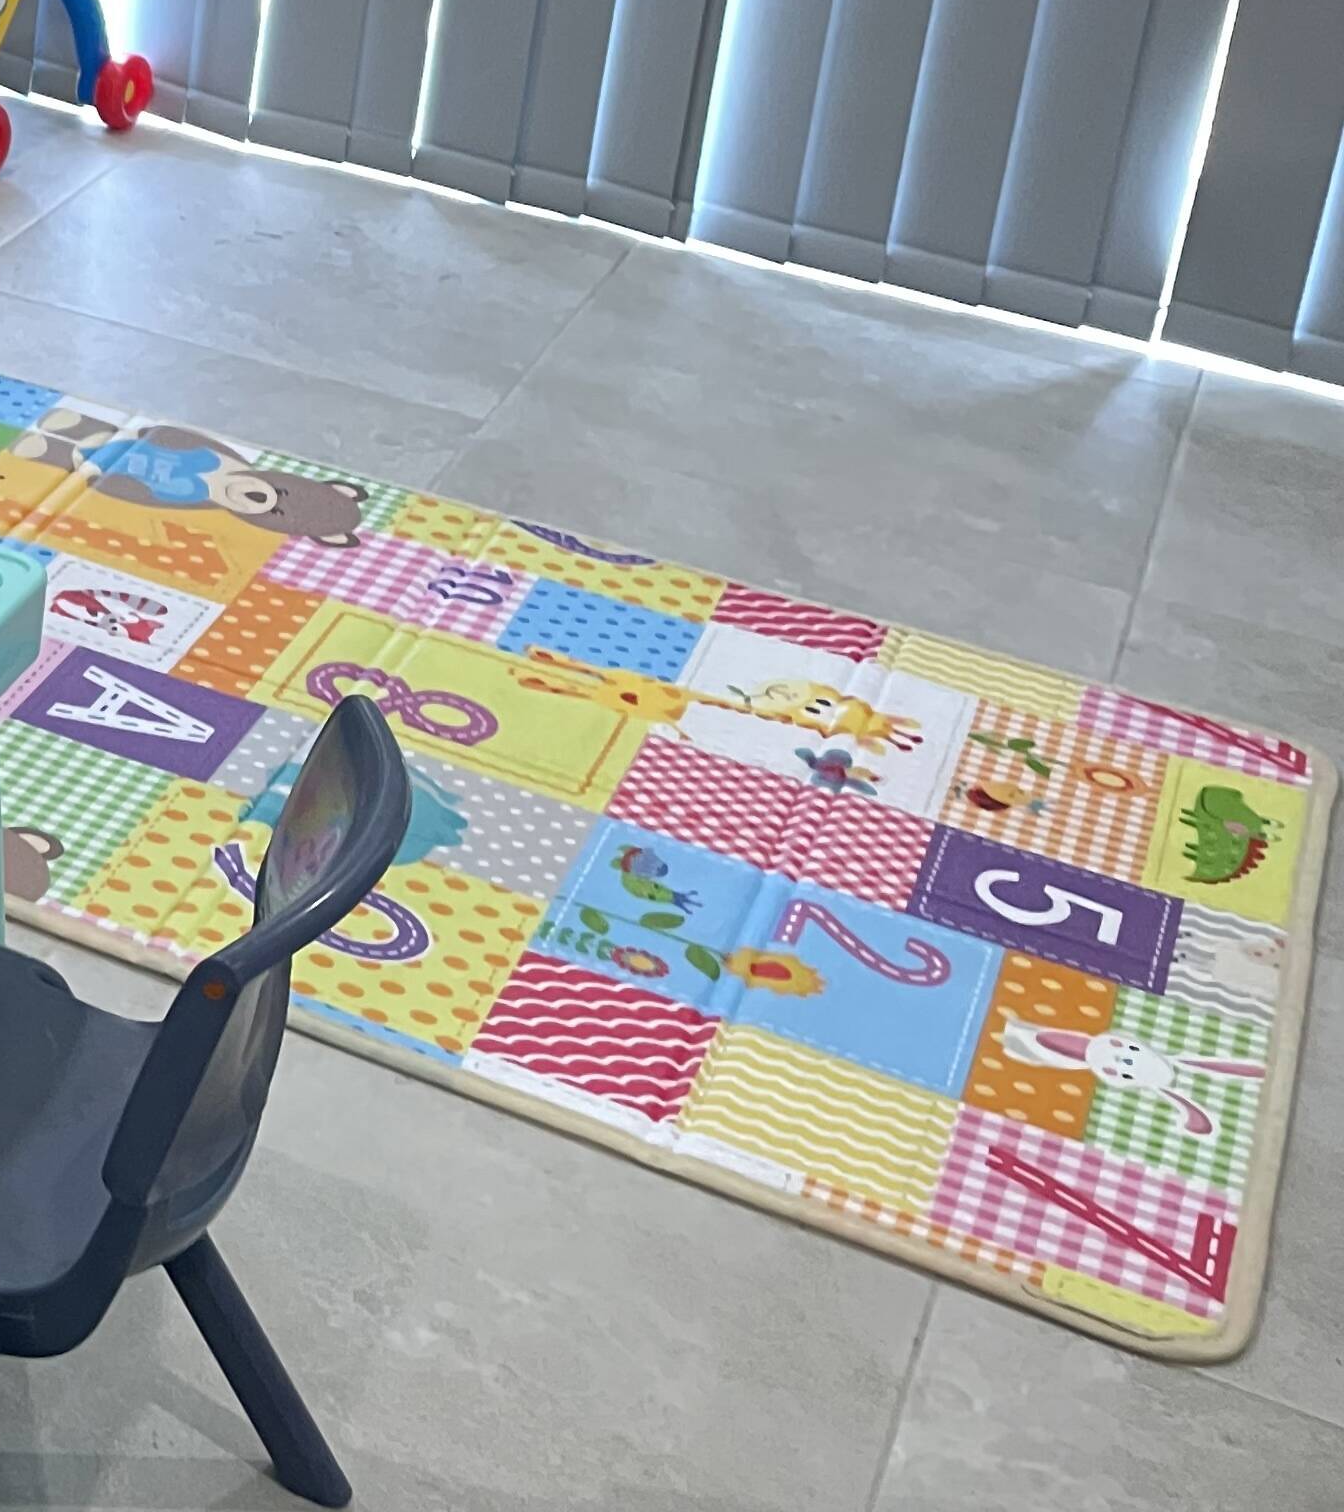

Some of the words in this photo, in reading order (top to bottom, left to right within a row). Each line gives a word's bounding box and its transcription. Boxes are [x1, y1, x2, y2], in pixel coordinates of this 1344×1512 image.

[45, 664, 216, 745] A
[305, 661, 500, 747] 8
[774, 898, 951, 988] 2
[973, 868, 1124, 947] 5
[984, 1144, 1239, 1304] 7
